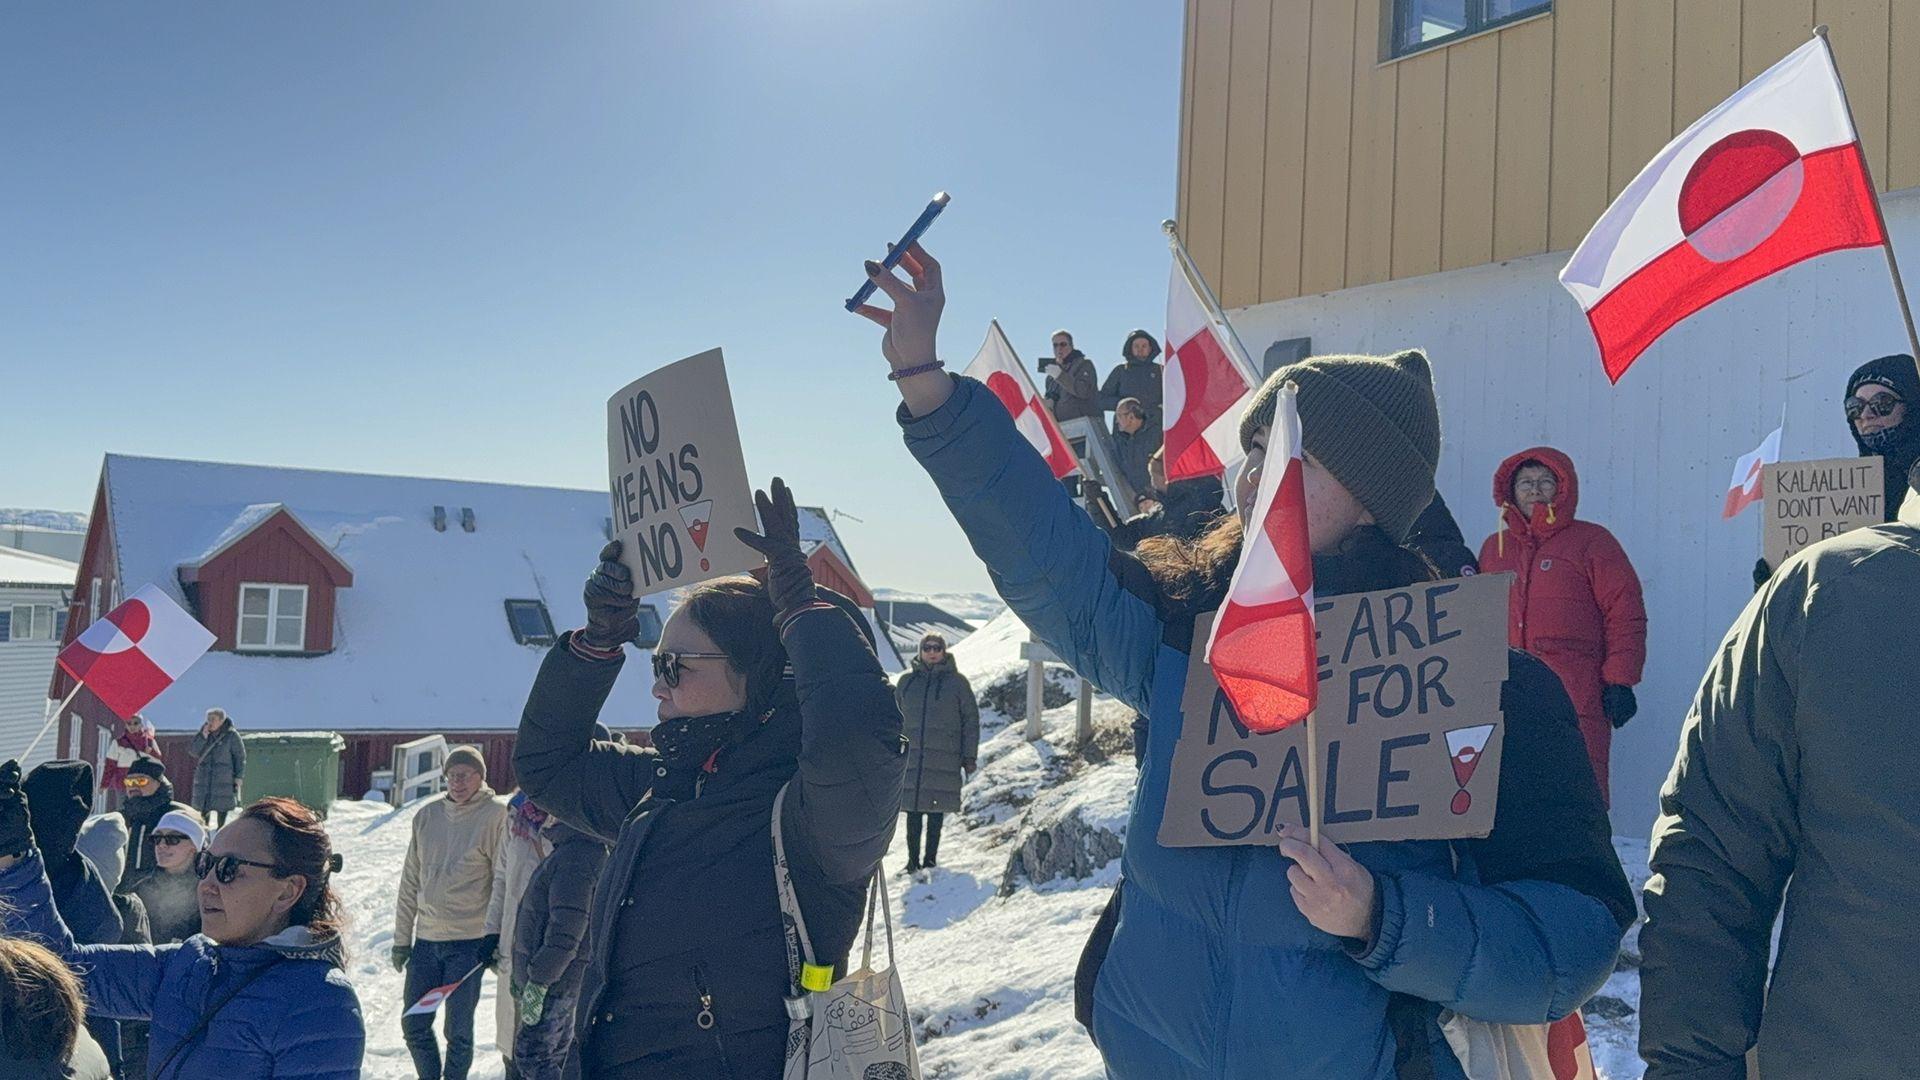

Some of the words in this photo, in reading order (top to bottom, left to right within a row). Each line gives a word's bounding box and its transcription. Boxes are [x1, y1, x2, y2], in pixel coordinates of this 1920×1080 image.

[620, 390, 659, 464] NO
[612, 443, 703, 533] MEANS
[1777, 466, 1872, 493] KALAALLIT
[1830, 495, 1881, 516] WANT
[1781, 525, 1809, 546] TO
[1821, 521, 1849, 540] BE
[1341, 584, 1463, 664] ARE
[1347, 656, 1455, 724] FOR
